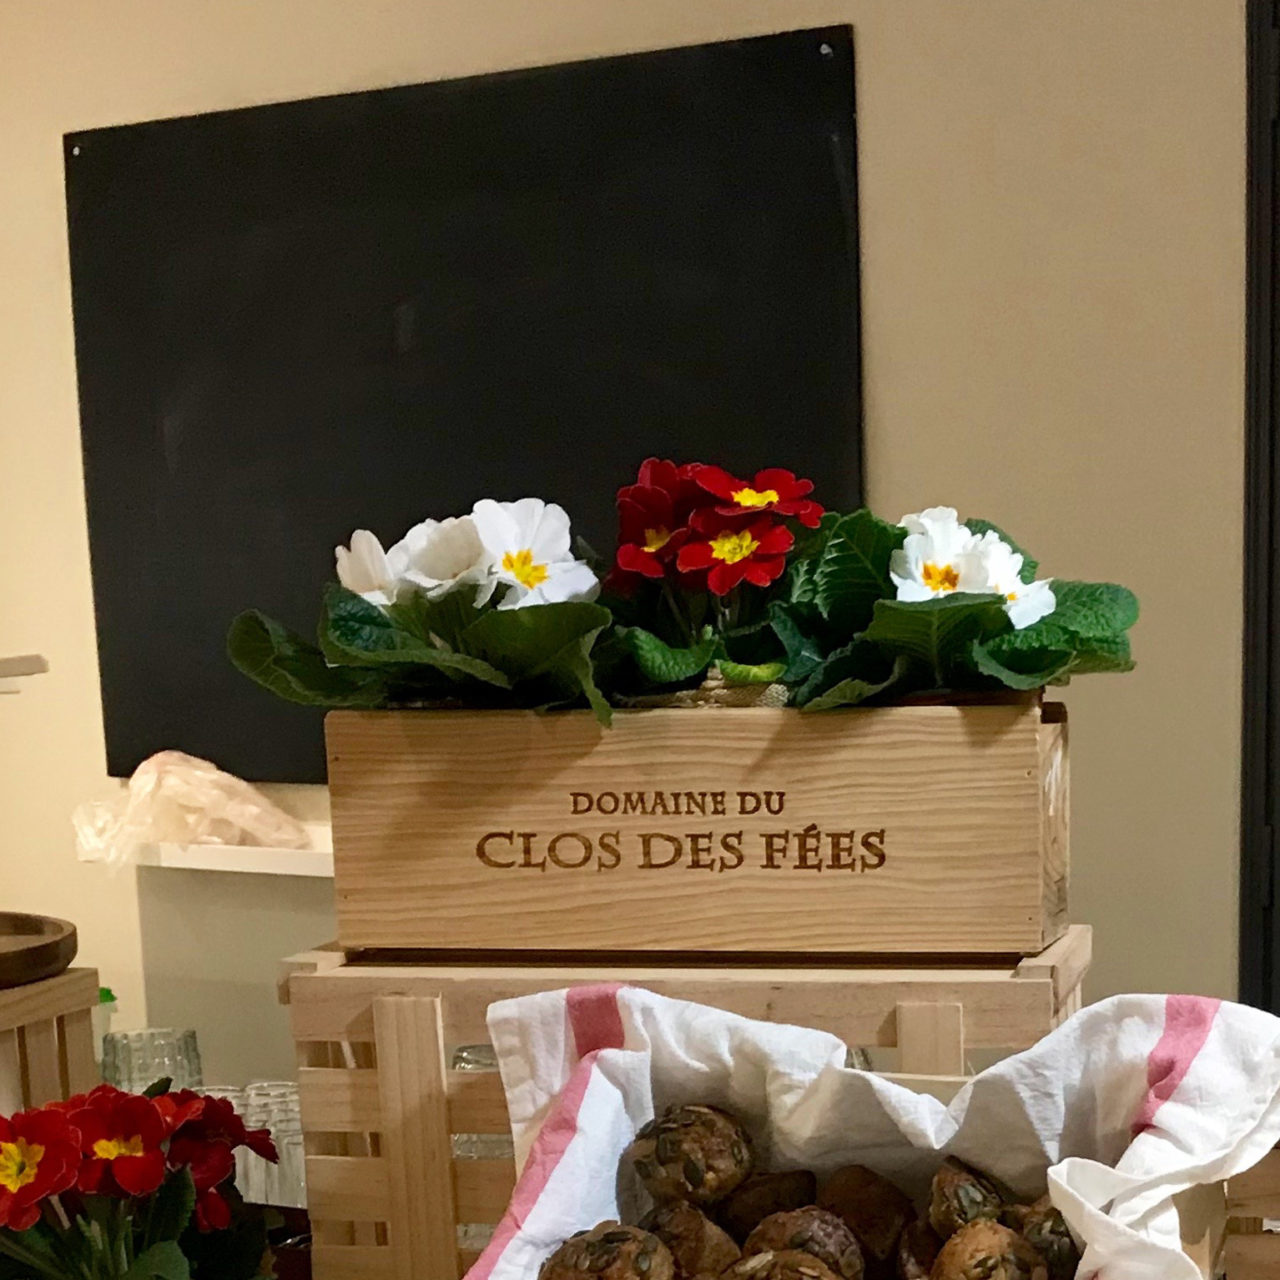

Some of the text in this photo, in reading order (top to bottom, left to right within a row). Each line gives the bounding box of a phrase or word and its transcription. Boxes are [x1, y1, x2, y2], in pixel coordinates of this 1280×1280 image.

[570, 791, 786, 816] DOMAINE DU
[475, 823, 887, 873] CLOS DES FÉES
